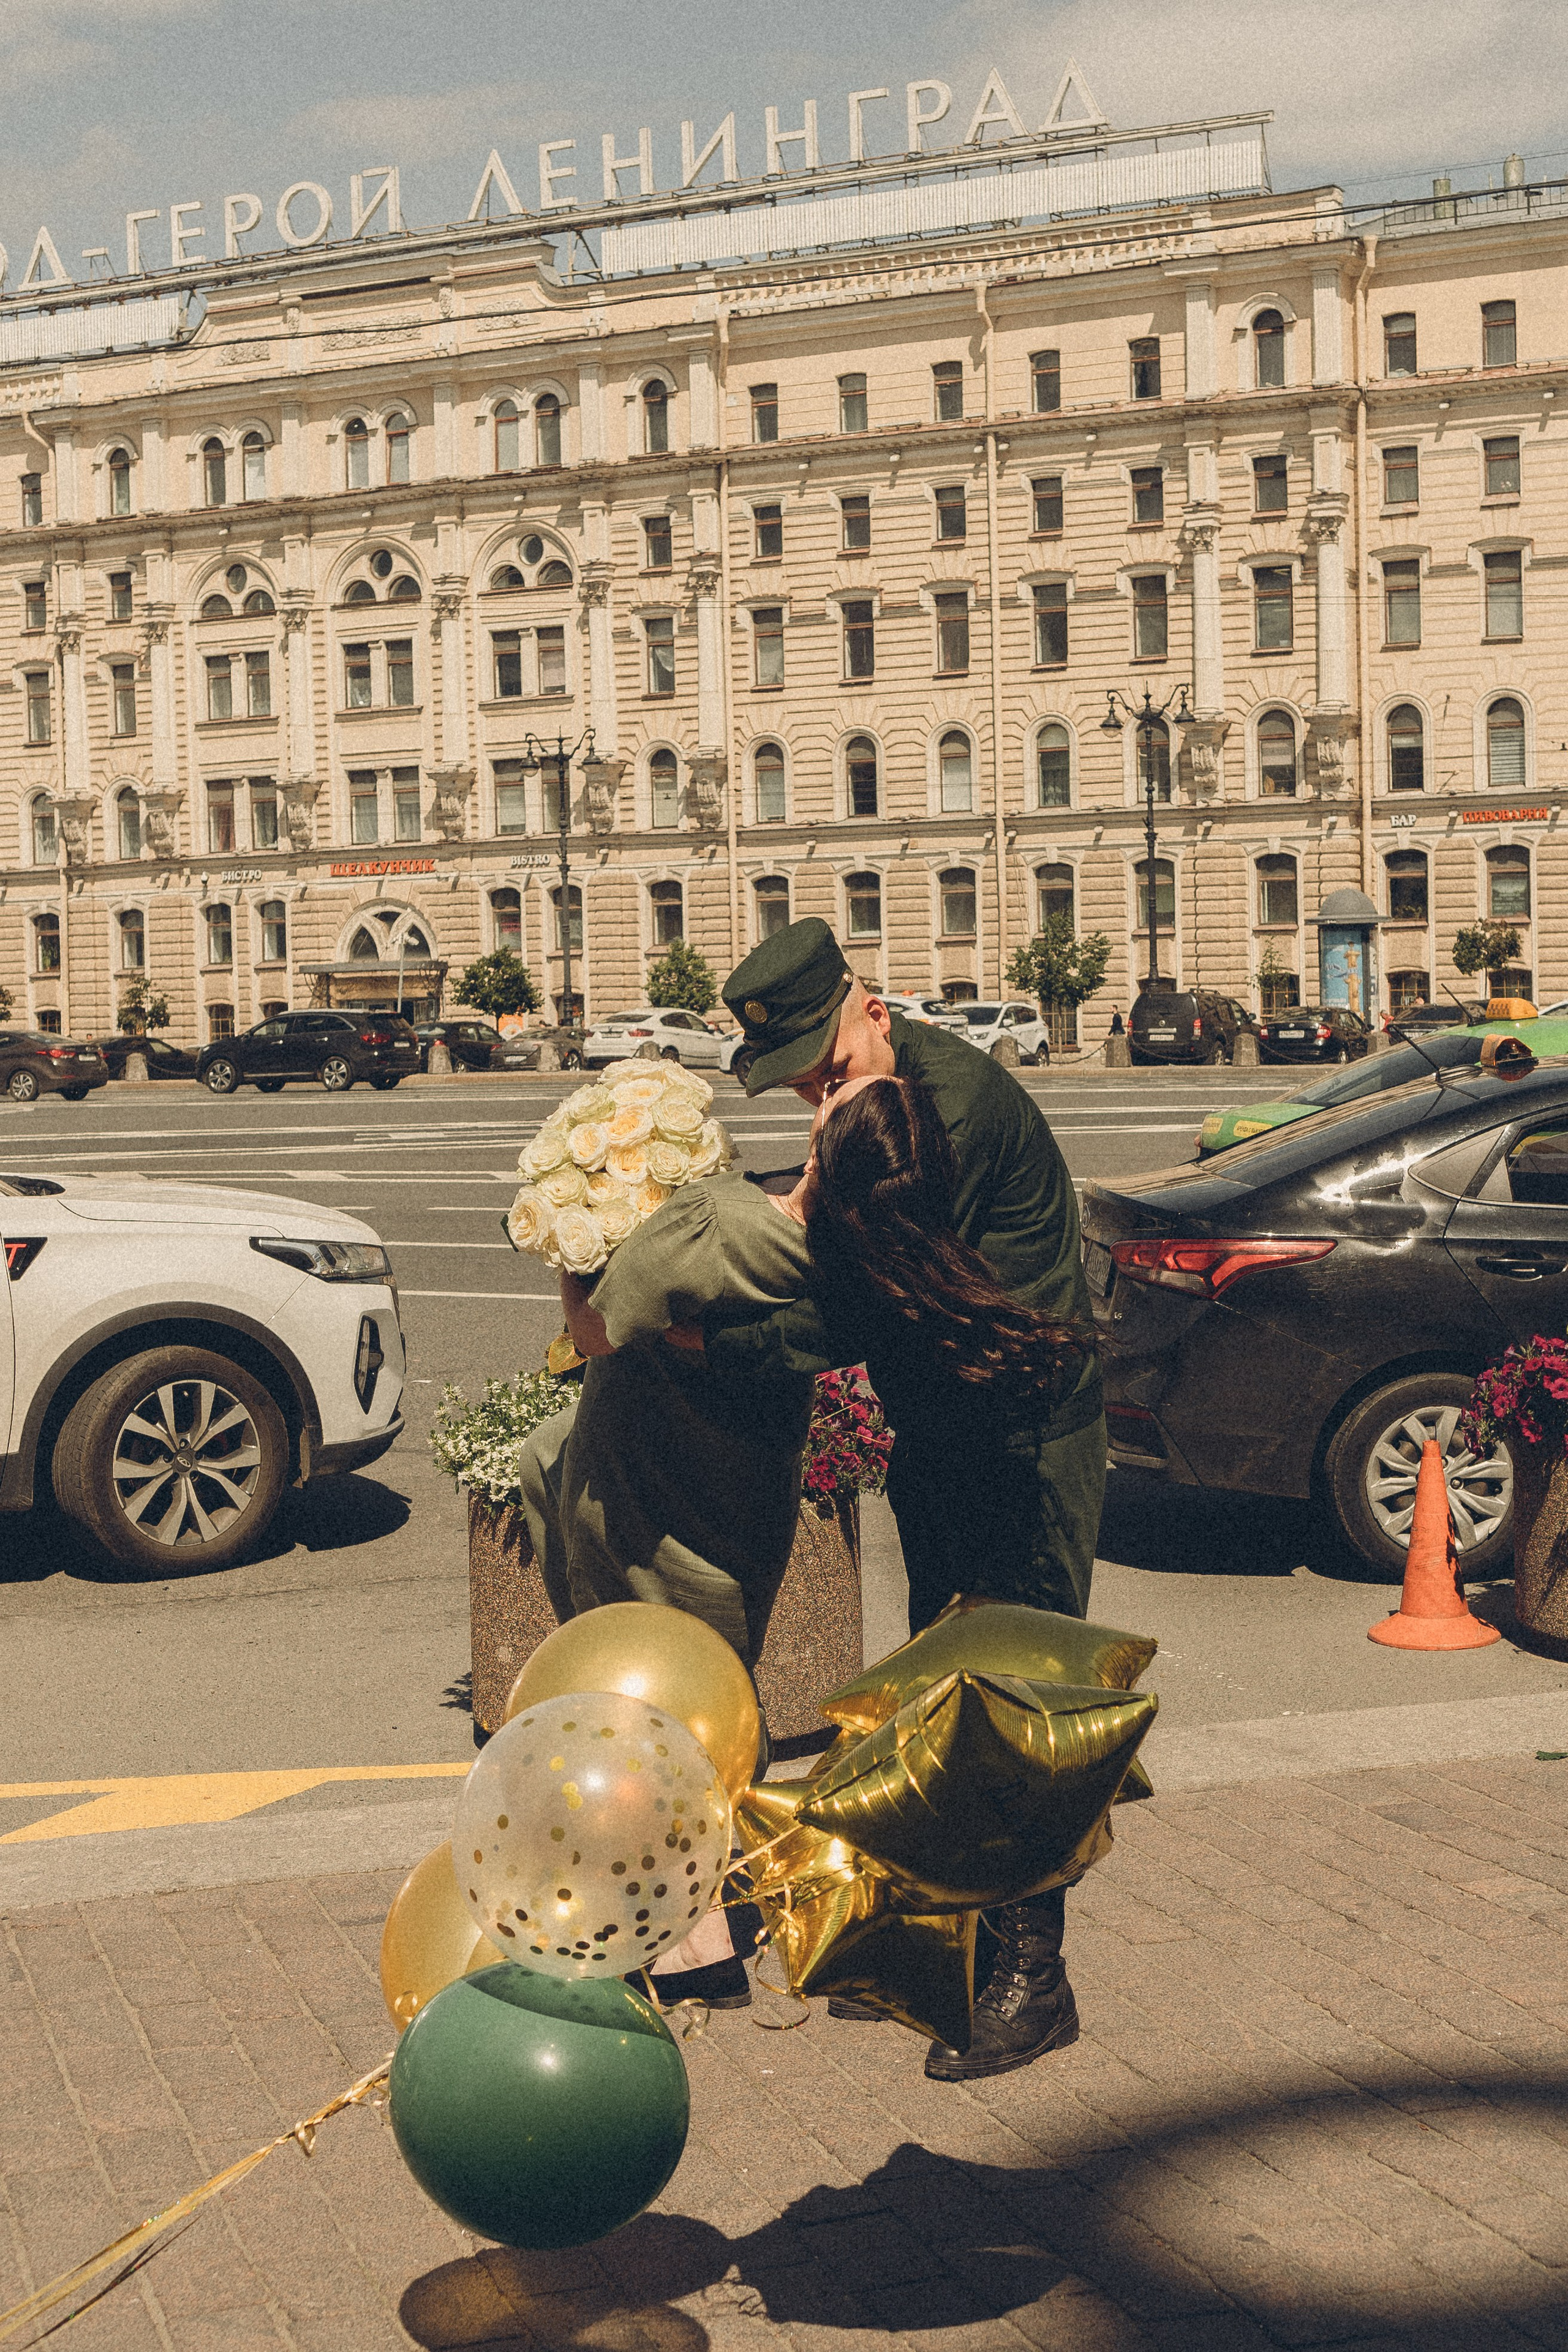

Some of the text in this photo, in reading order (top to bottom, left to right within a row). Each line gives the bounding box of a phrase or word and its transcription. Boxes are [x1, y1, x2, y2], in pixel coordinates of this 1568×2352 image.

[467, 56, 1106, 221] ЛЕНИНГРАД
[1390, 814, 1417, 827] БАР
[1463, 807, 1547, 823] ПИВОВАРНЯ
[511, 854, 550, 865] BISTRO
[330, 859, 435, 876] ЩЕЛКУНЧИК
[221, 870, 262, 881] БИСТРО
